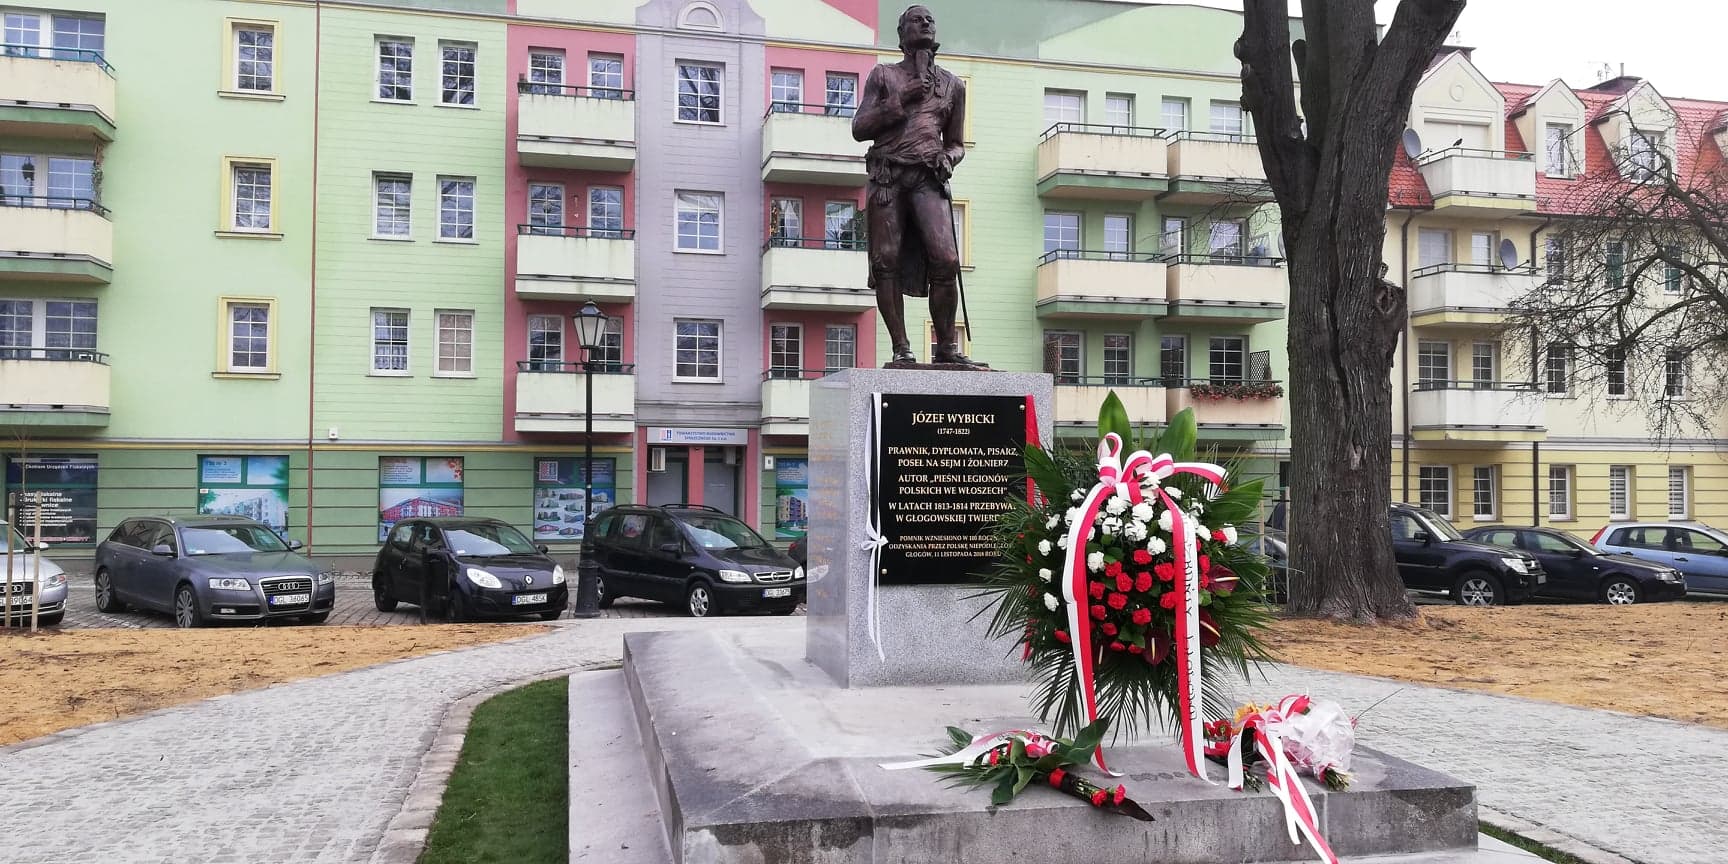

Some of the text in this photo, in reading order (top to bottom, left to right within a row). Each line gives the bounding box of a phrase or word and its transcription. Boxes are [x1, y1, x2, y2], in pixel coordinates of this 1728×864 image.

[911, 410, 995, 426] JÓZEF WYBICKI
[888, 446, 1018, 456] PRAWNIK, DYPLOMATA, PISARZ,
[926, 459, 939, 467] NA
[940, 459, 961, 468] SEJM
[963, 459, 966, 467] I
[898, 474, 928, 483] AUTOR
[963, 473, 1008, 483] LEGIONÓW
[899, 486, 941, 495] POLSKICH
[943, 486, 957, 495] WE
[888, 502, 897, 510] W
[898, 502, 932, 510] LATACH
[934, 502, 968, 510] 1813-1814
[895, 514, 1004, 524] W GŁOGOWSKIEJ TWIERD
